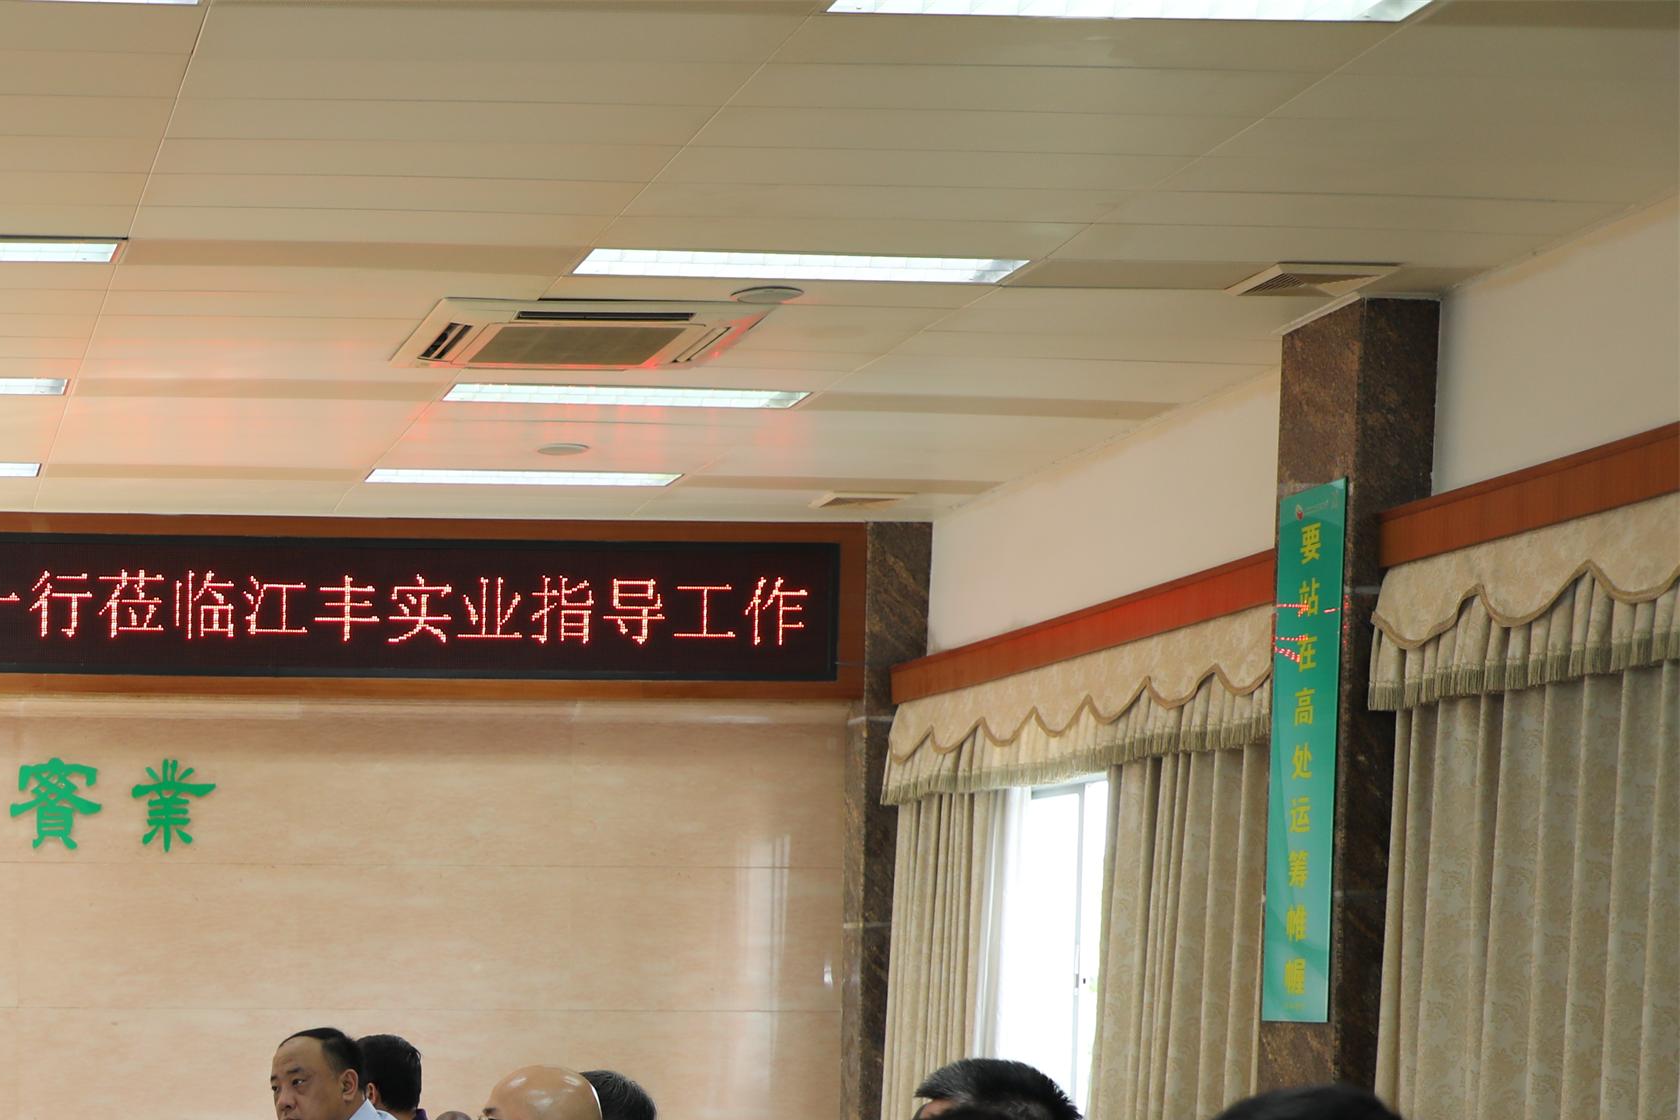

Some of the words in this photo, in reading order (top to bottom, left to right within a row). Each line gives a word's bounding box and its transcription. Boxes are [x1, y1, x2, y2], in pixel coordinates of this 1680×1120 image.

[1283, 522, 1322, 995] 要站在高处运筹帷幄
